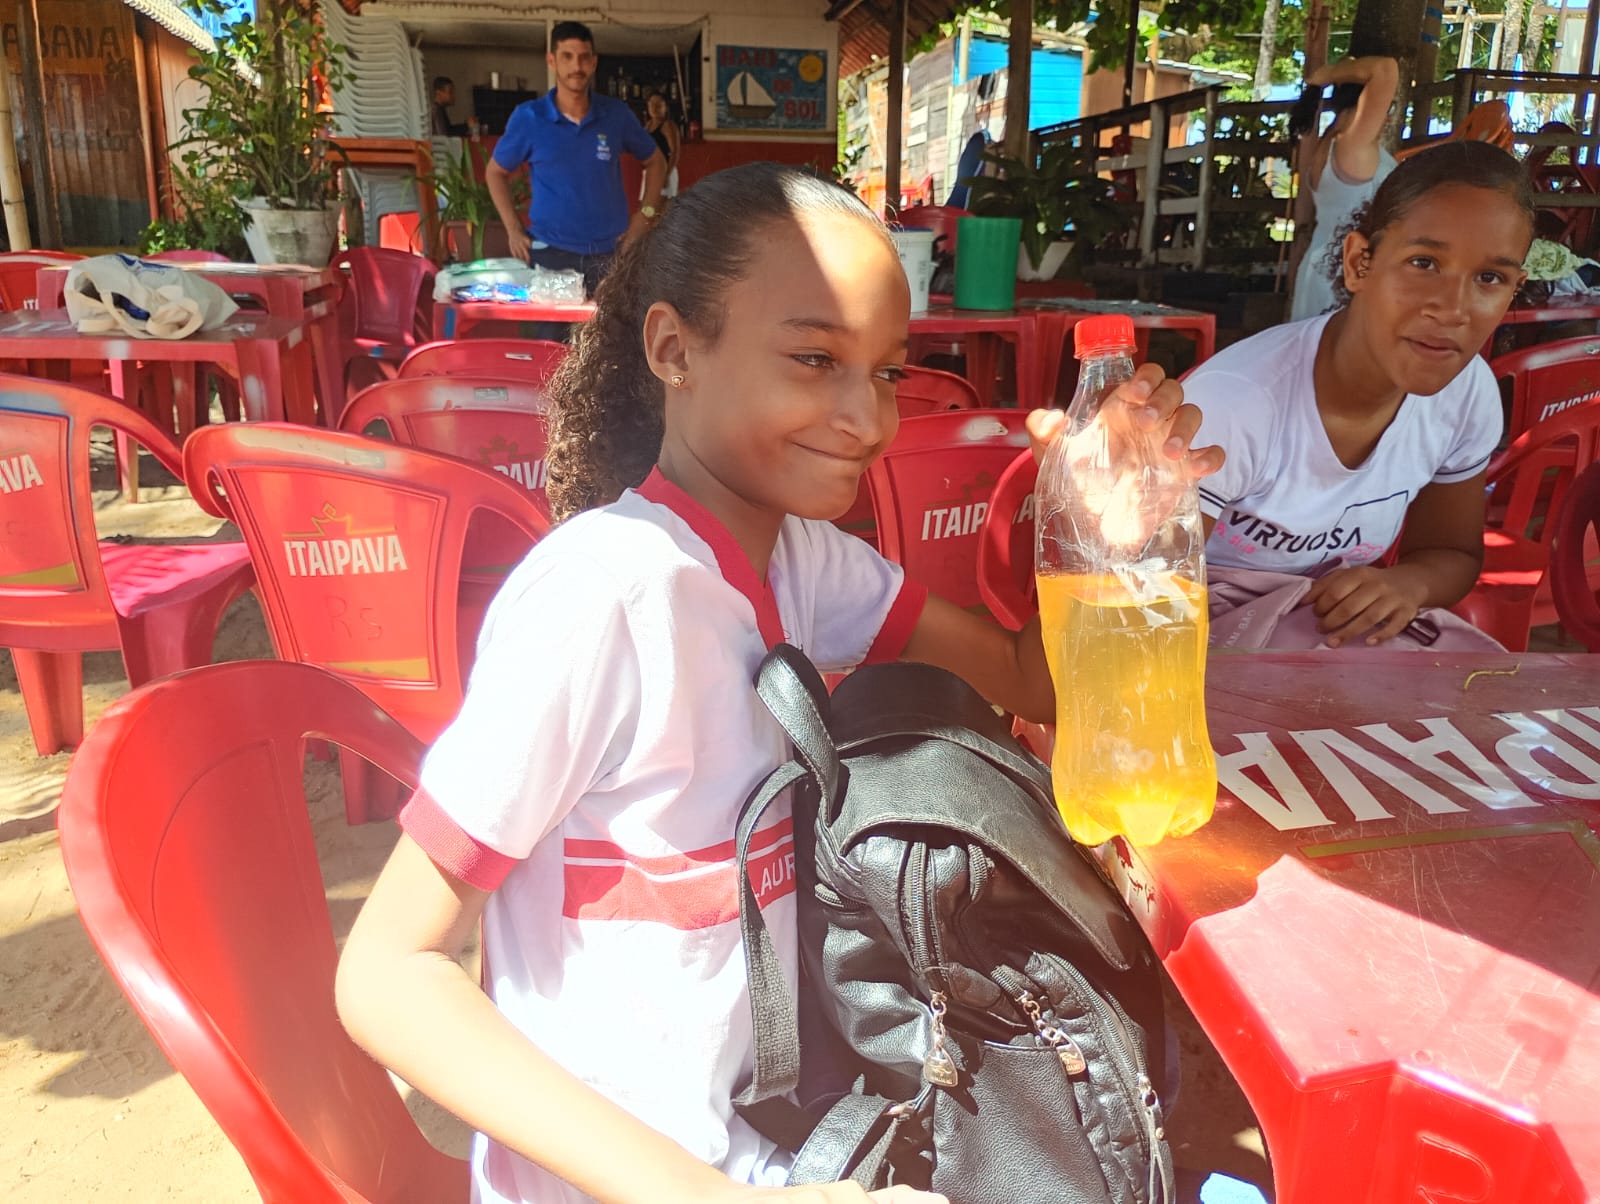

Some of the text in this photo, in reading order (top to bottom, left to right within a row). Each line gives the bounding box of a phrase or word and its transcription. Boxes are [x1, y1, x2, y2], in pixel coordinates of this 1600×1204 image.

[784, 99, 822, 121] SOL
[1229, 511, 1362, 553] VIRTUOSA
[283, 535, 408, 576] ITAIPAVA
